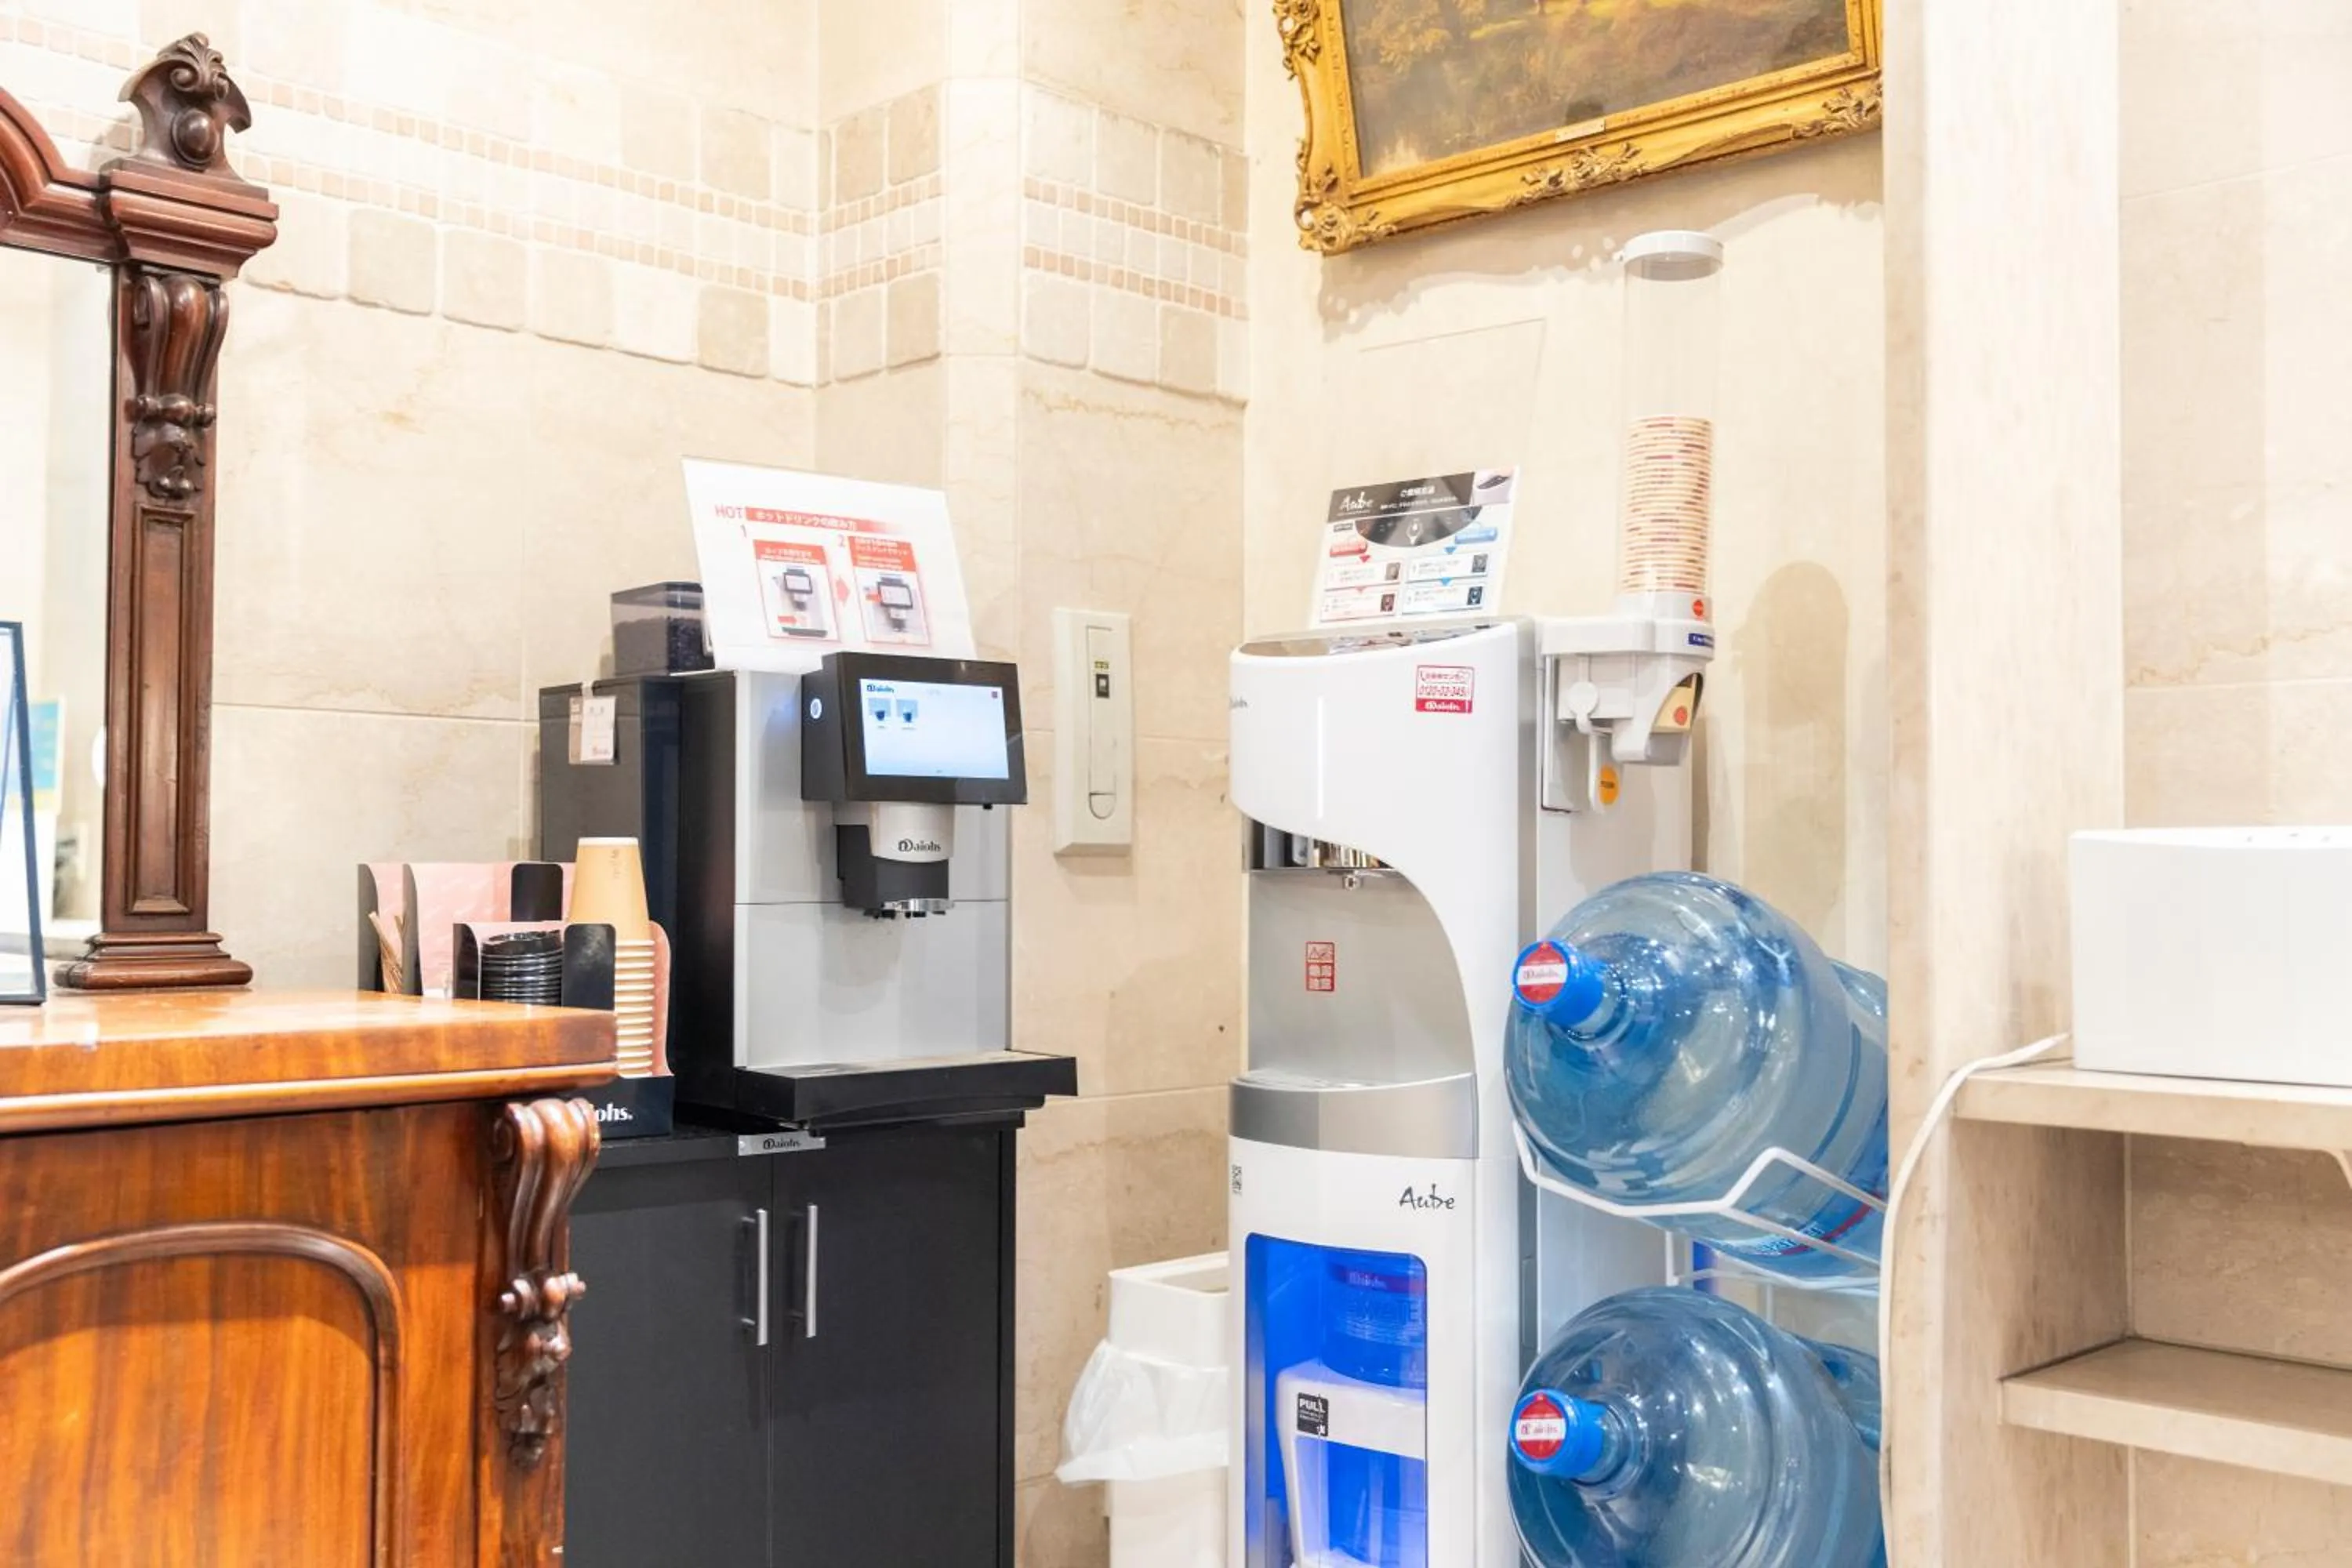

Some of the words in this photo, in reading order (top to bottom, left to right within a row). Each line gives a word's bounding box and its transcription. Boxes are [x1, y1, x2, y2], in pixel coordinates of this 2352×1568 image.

[714, 504, 743, 520] HOT
[898, 838, 942, 853] Daiohs
[1399, 1183, 1456, 1210] Aube
[1299, 1398, 1327, 1414] PULL
